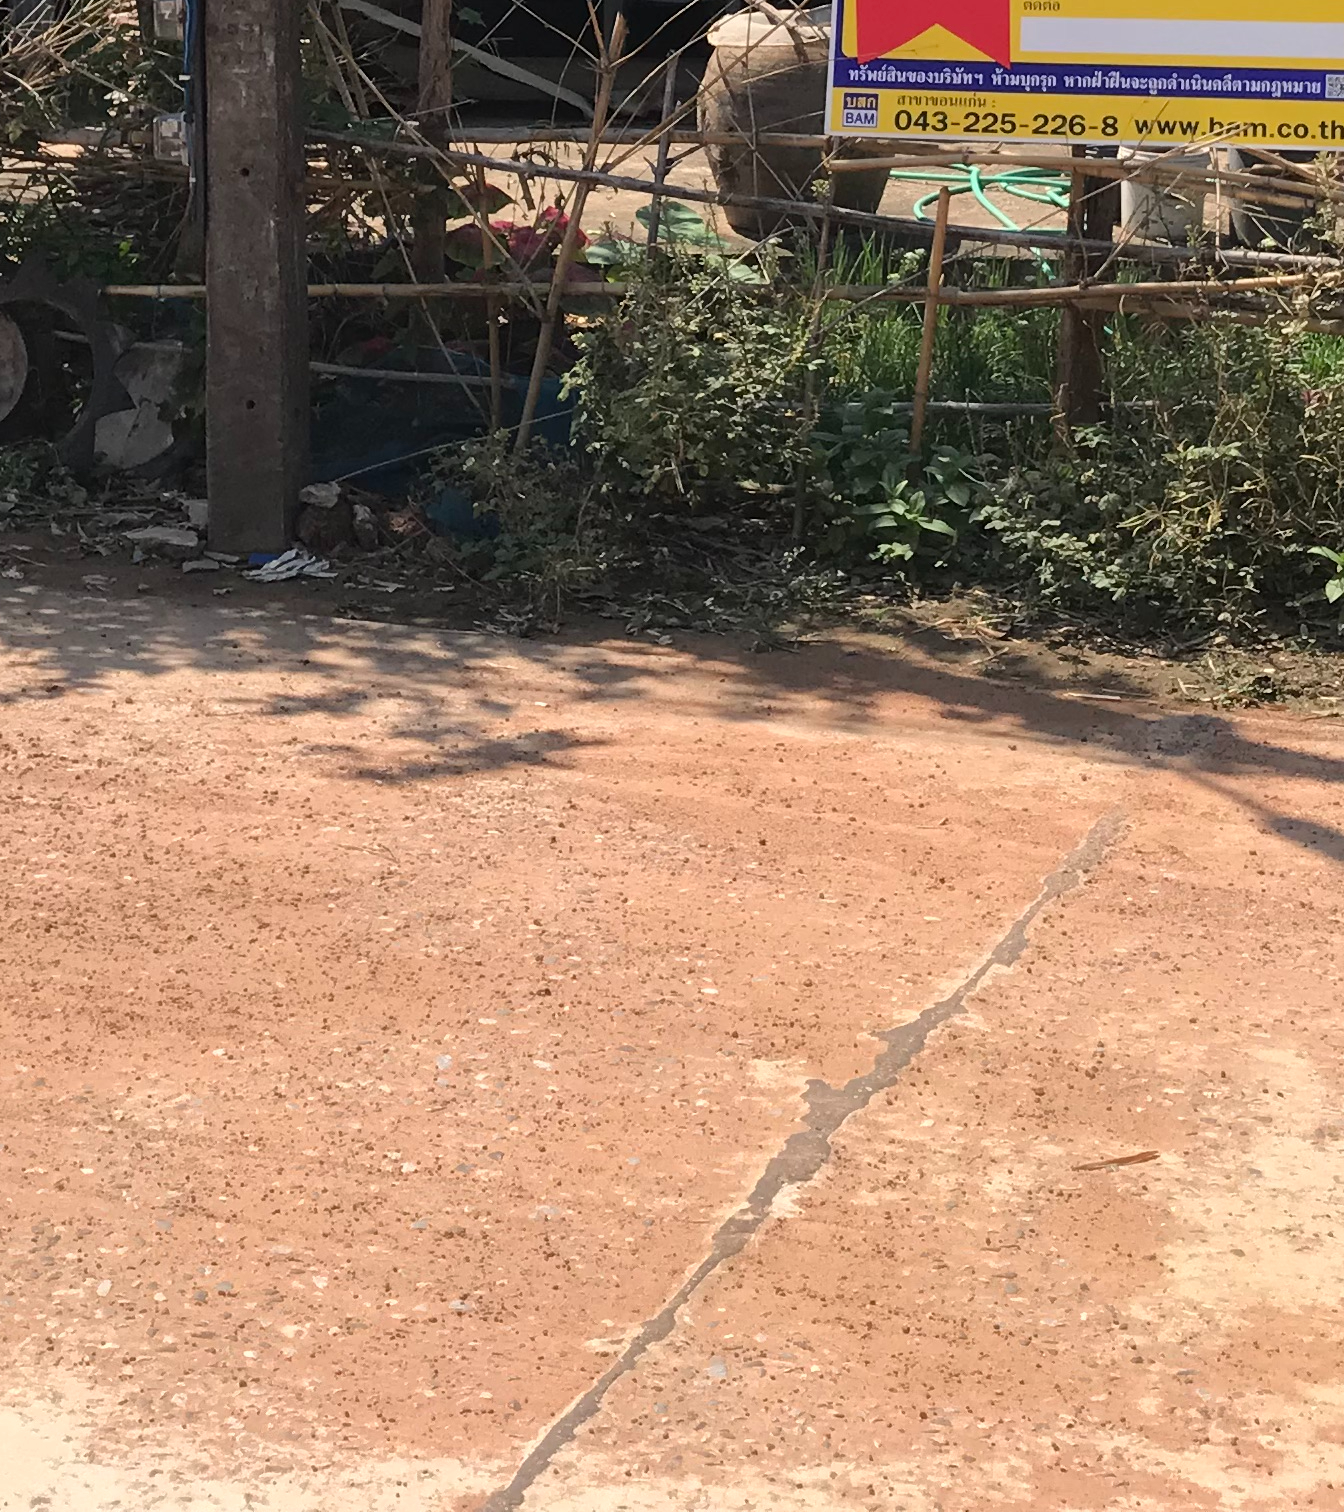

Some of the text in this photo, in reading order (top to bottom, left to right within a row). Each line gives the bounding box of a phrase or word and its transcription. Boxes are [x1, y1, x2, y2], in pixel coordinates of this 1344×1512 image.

[848, 64, 984, 85] ทรัพย์สินของบริษัทฯ
[991, 68, 1057, 92] ห้ามบุกรุก
[845, 96, 877, 109] บสก
[896, 93, 987, 108] สาขาขอนแก่น
[845, 112, 875, 125] BAM
[894, 110, 1119, 136] 043-225-226-8
